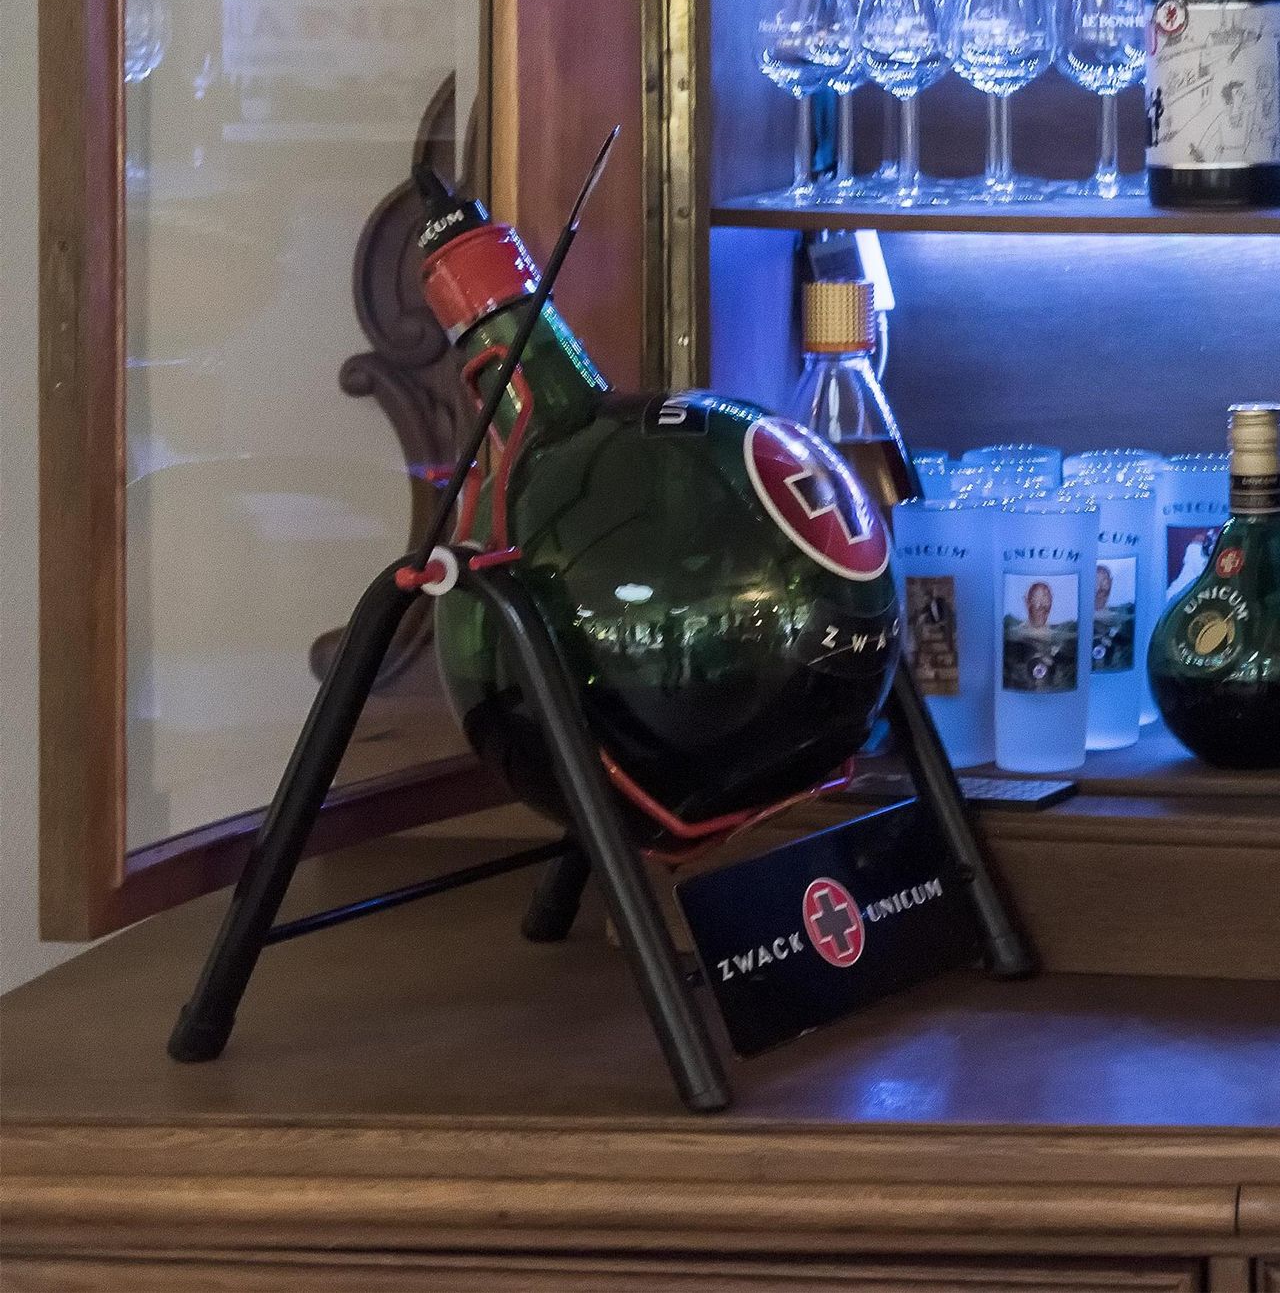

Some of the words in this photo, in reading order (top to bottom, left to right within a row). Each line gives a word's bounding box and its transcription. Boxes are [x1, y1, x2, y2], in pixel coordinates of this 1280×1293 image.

[903, 545, 967, 559] NICUM
[1003, 548, 1080, 563] UNICUM
[1184, 585, 1249, 622] UNICUM
[866, 877, 943, 923] UNICUM
[717, 931, 804, 982] ZWACK
